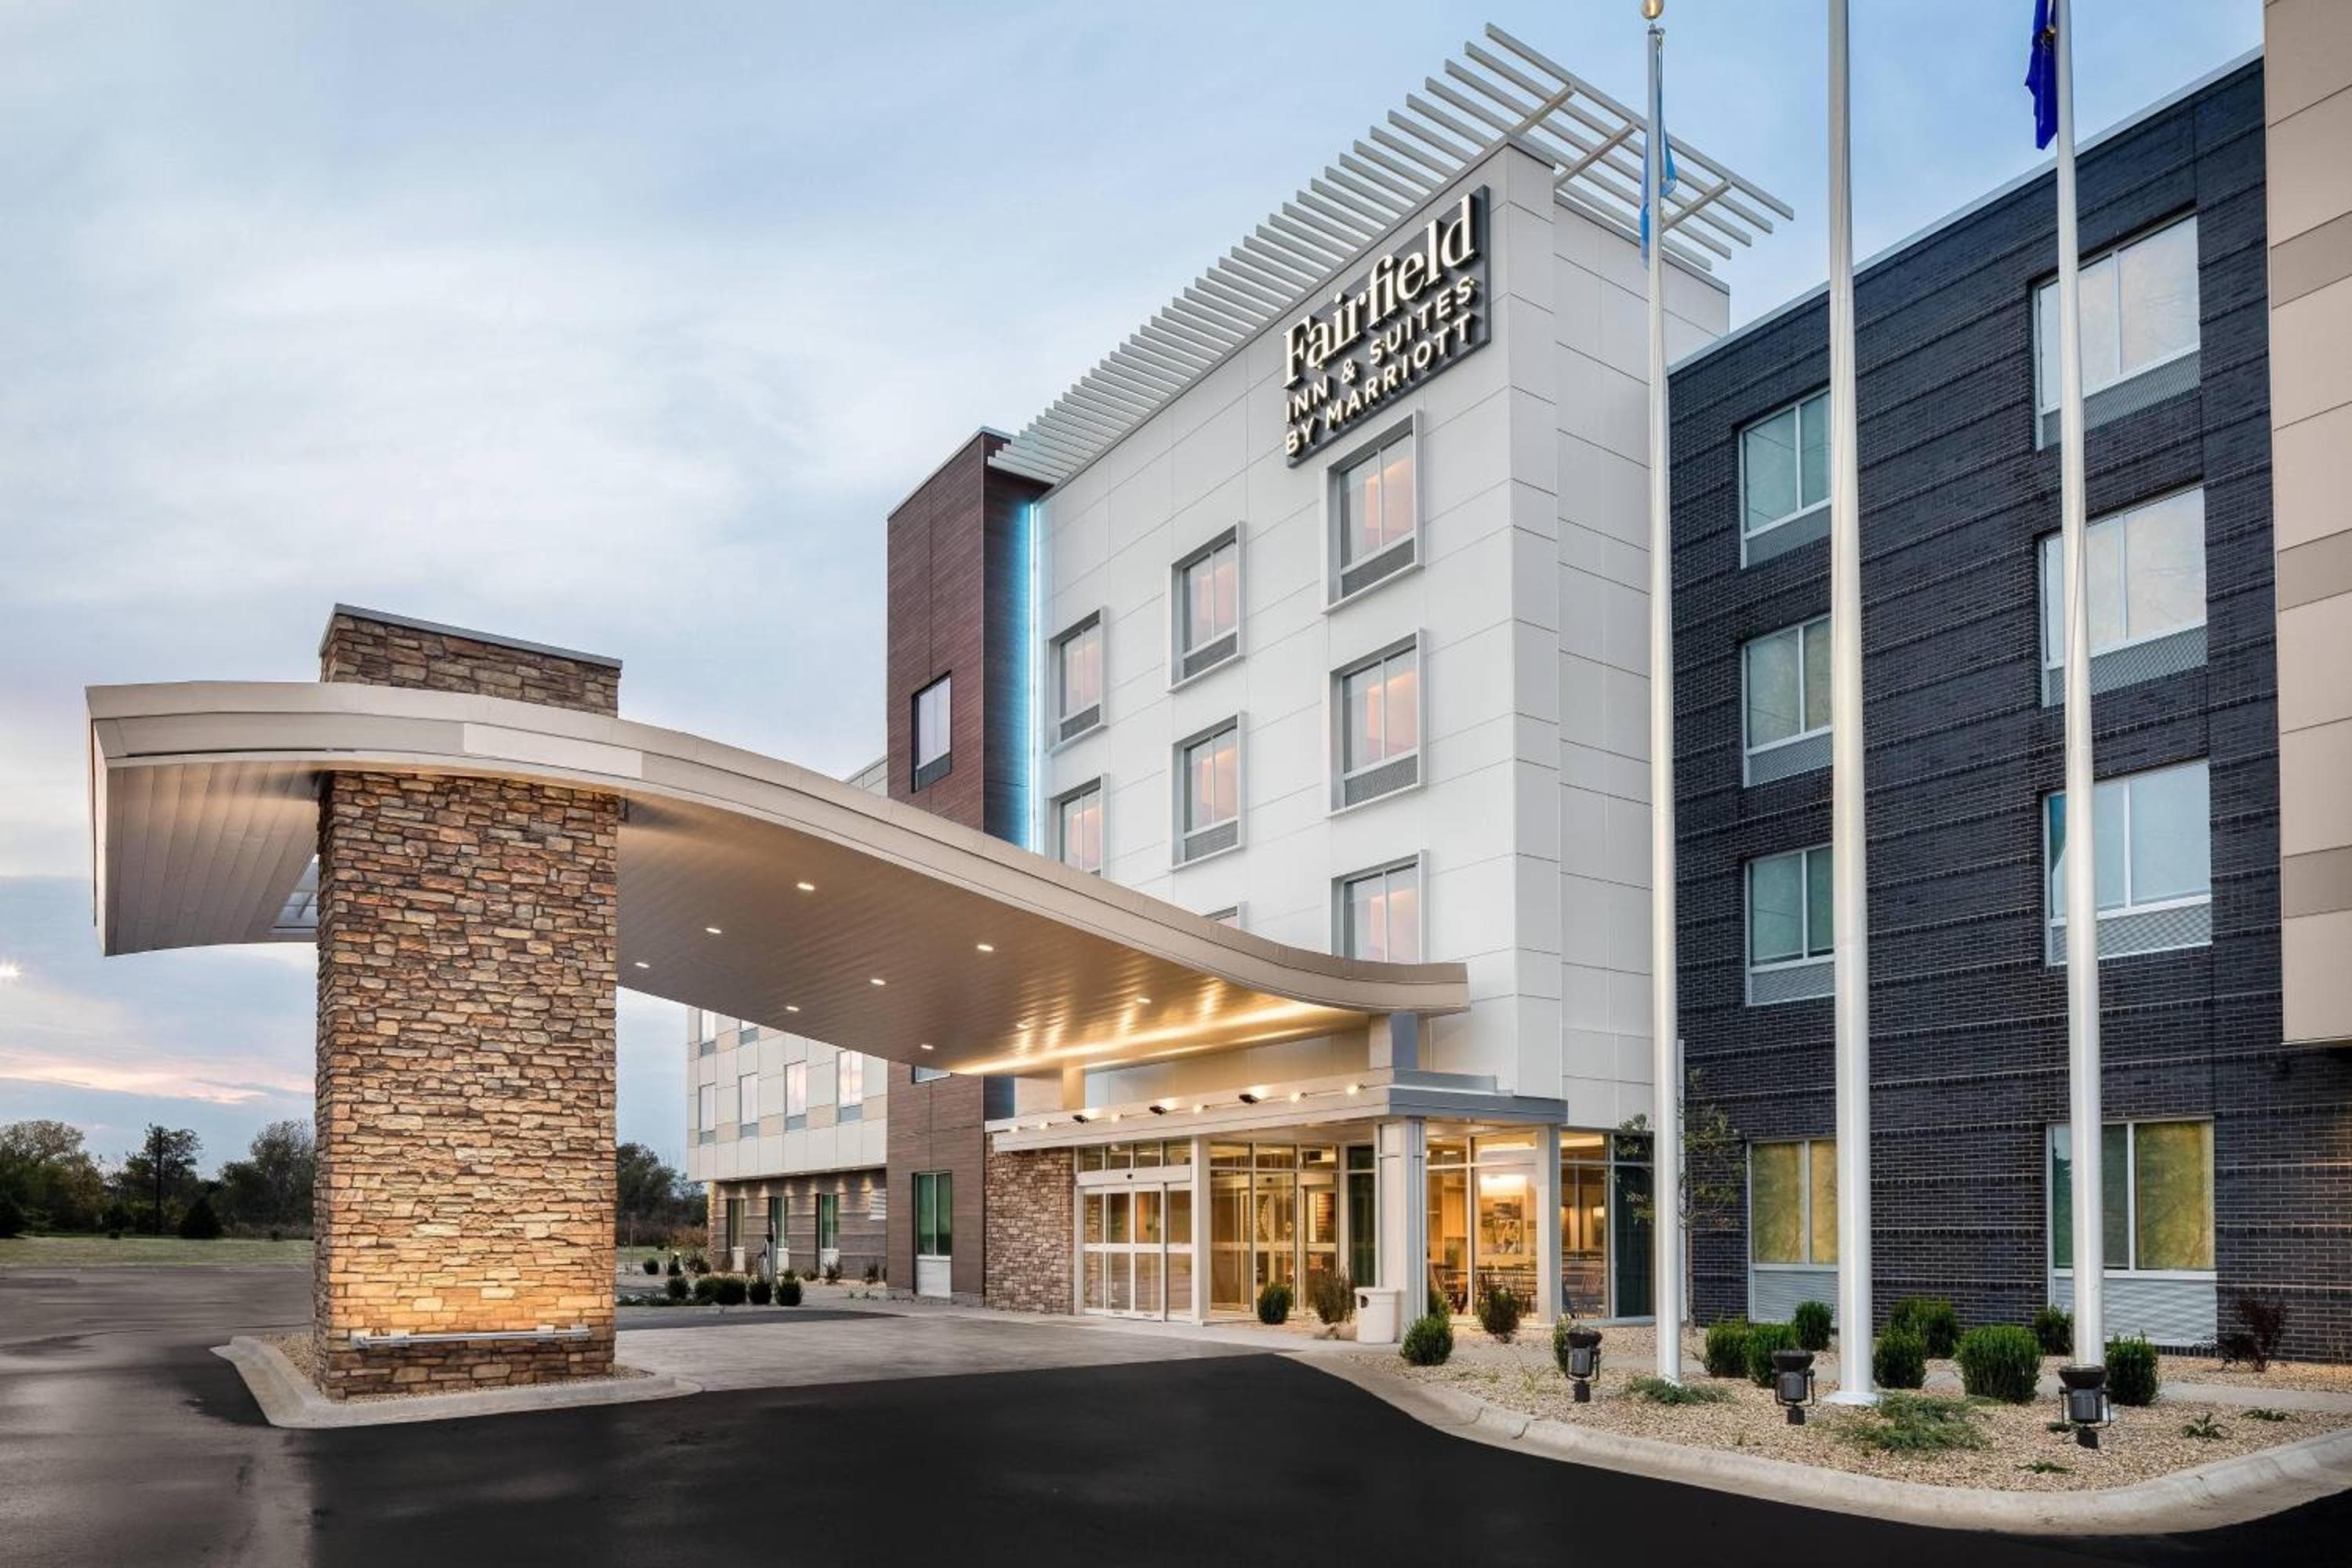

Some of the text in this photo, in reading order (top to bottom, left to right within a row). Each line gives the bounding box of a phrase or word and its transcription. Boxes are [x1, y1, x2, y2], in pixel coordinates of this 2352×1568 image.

[1282, 194, 1475, 389] Fairfield
[1286, 276, 1475, 423] INN & SUITES
[1286, 313, 1472, 456] BY MARRIOTT
